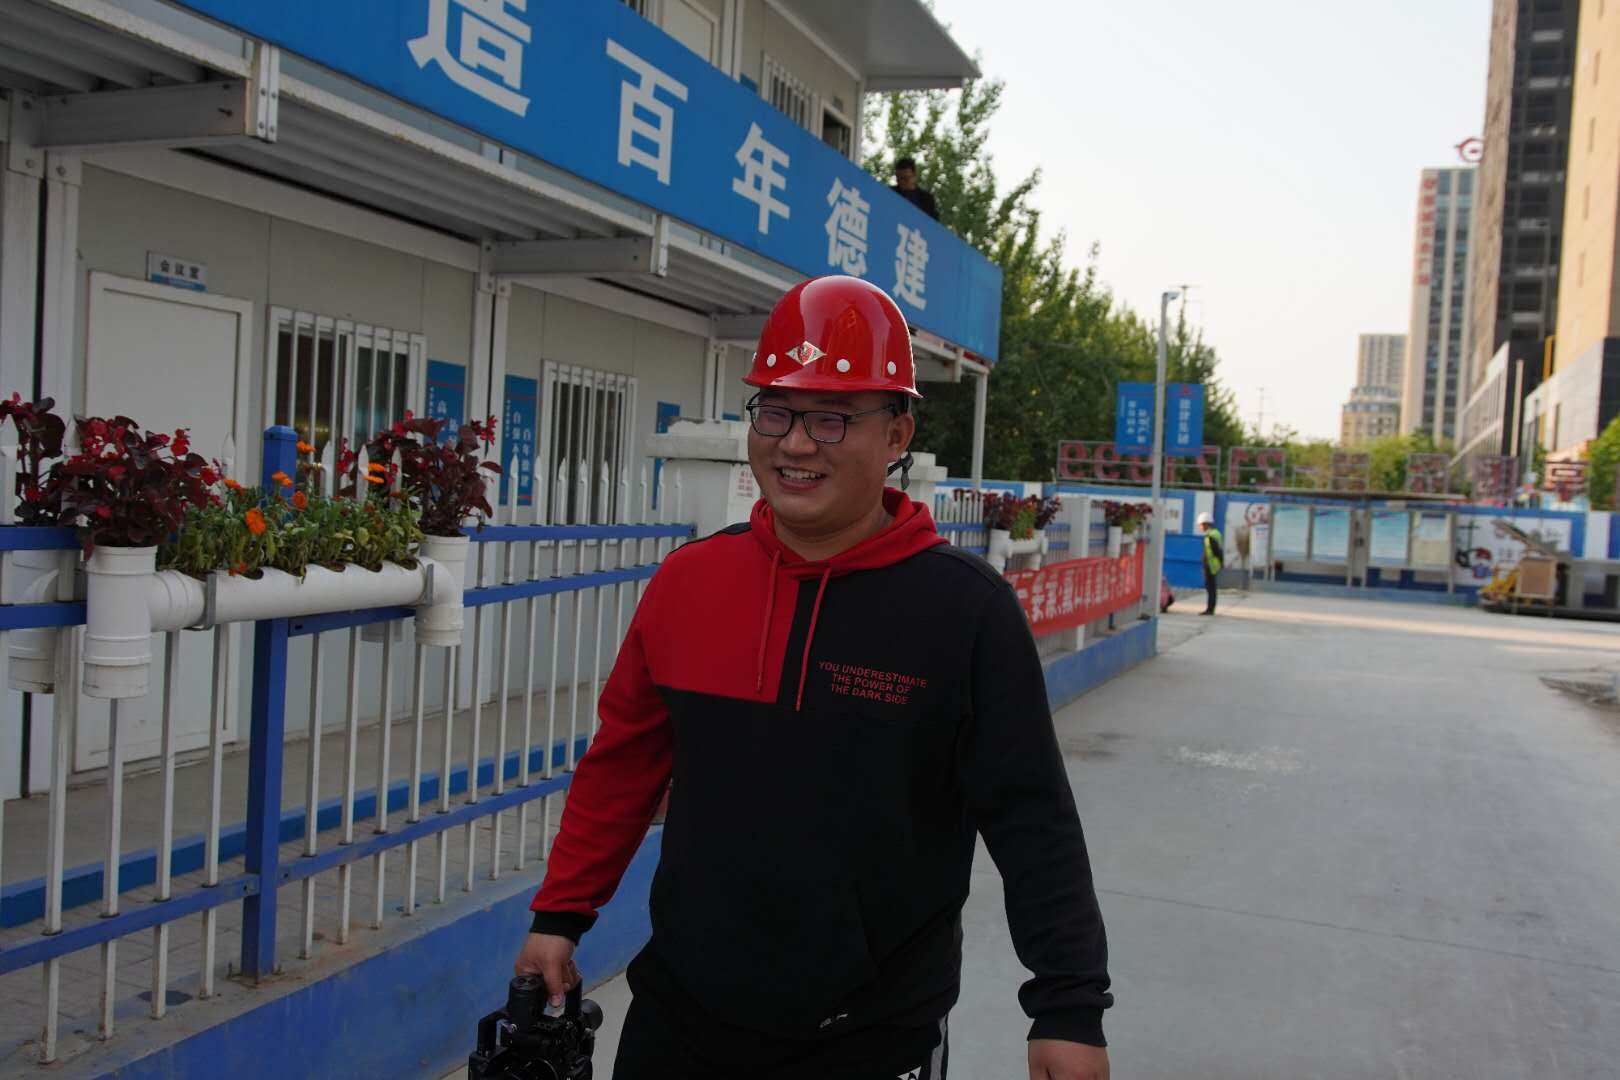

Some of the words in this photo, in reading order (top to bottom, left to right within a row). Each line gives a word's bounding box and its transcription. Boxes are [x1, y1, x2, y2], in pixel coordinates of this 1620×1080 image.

[406, 0, 930, 311] 造百年德建
[818, 661, 841, 673] YOU
[842, 664, 927, 689] UNDERESTIMATE
[832, 673, 852, 685] THE
[854, 676, 893, 692] POWER
[896, 685, 912, 694] OF
[831, 683, 850, 696] THE
[851, 688, 881, 701] DARK
[884, 693, 909, 705] SIDE
